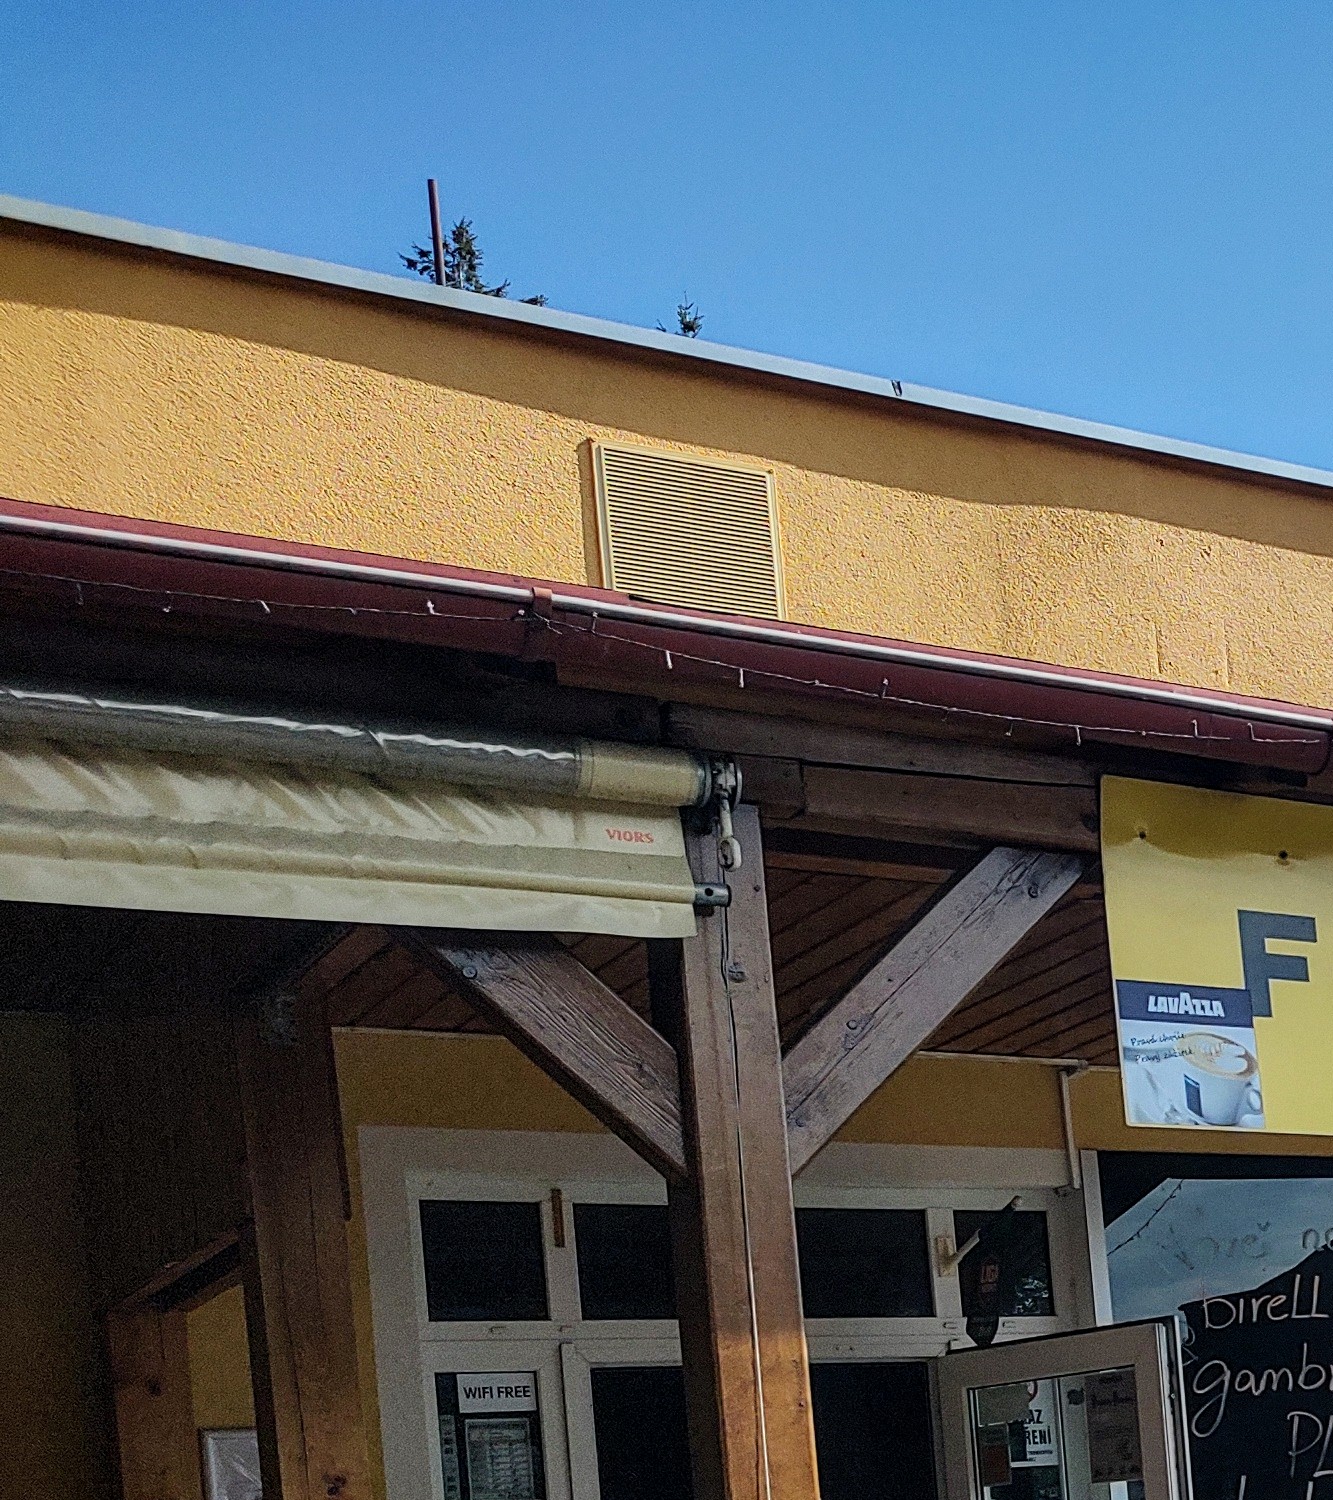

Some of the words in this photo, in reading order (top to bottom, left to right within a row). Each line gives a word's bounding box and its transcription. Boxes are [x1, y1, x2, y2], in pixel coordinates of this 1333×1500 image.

[605, 828, 655, 844] VIORS
[1148, 992, 1225, 1018] LAVAZZA
[497, 1385, 531, 1399] FREE
